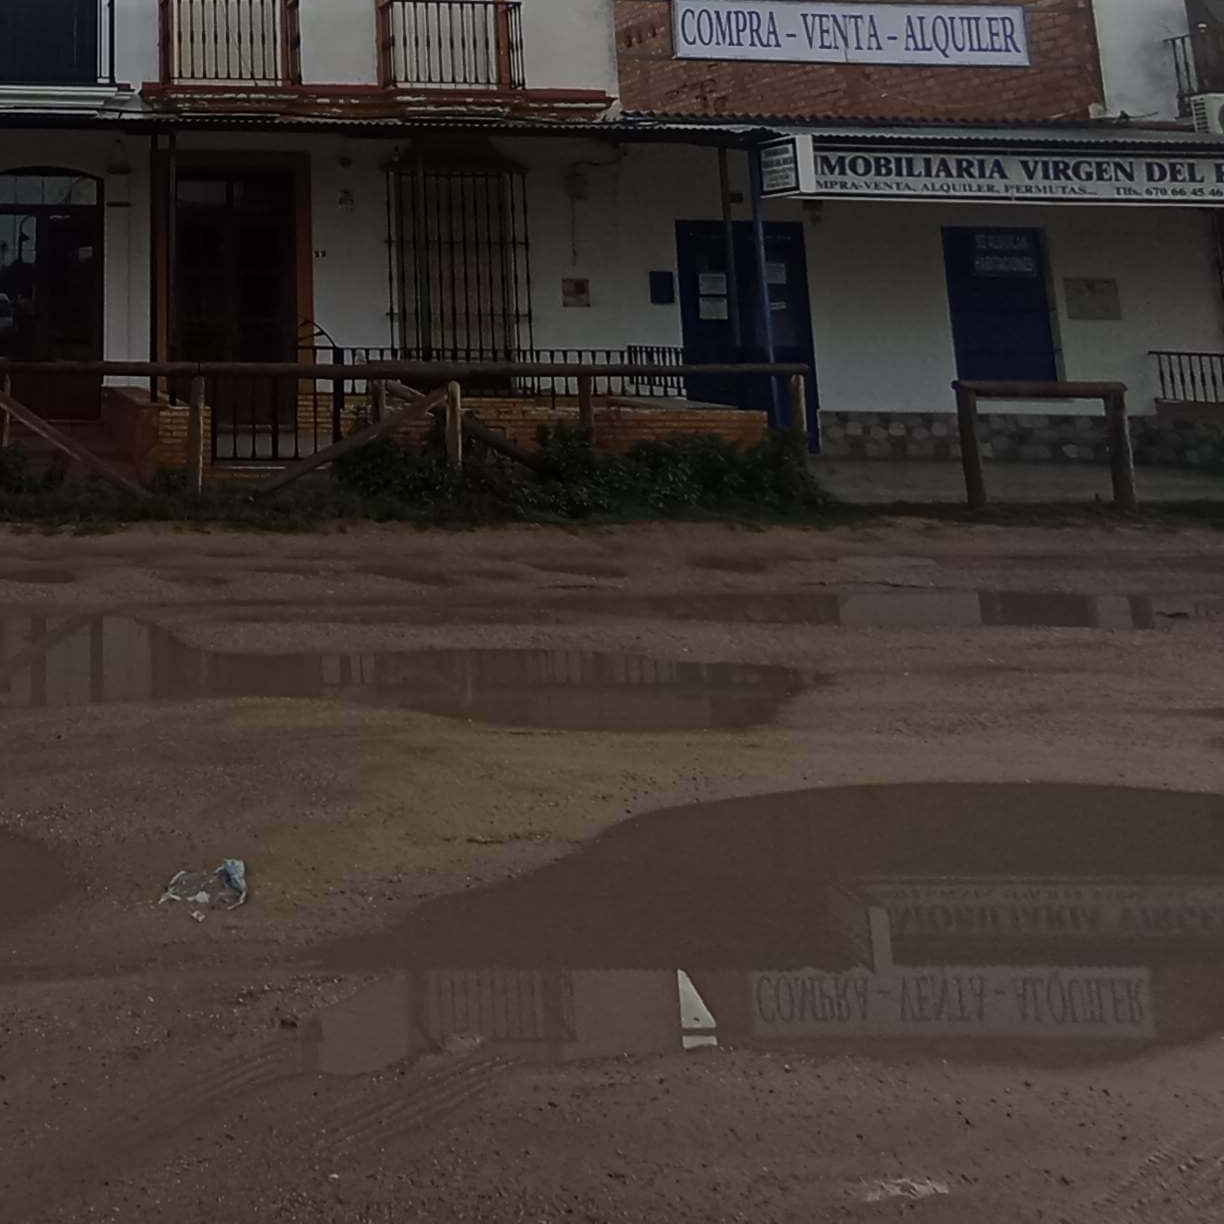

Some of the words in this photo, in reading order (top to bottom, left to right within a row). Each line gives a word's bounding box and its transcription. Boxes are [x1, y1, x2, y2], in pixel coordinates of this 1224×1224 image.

[680, 8, 782, 48] COMPRA
[800, 13, 883, 50] VENTA
[904, 15, 1022, 58] ALQUILER
[1018, 159, 1135, 182] VIRGEN
[1144, 161, 1205, 183] DEL
[1171, 187, 1187, 196] 66
